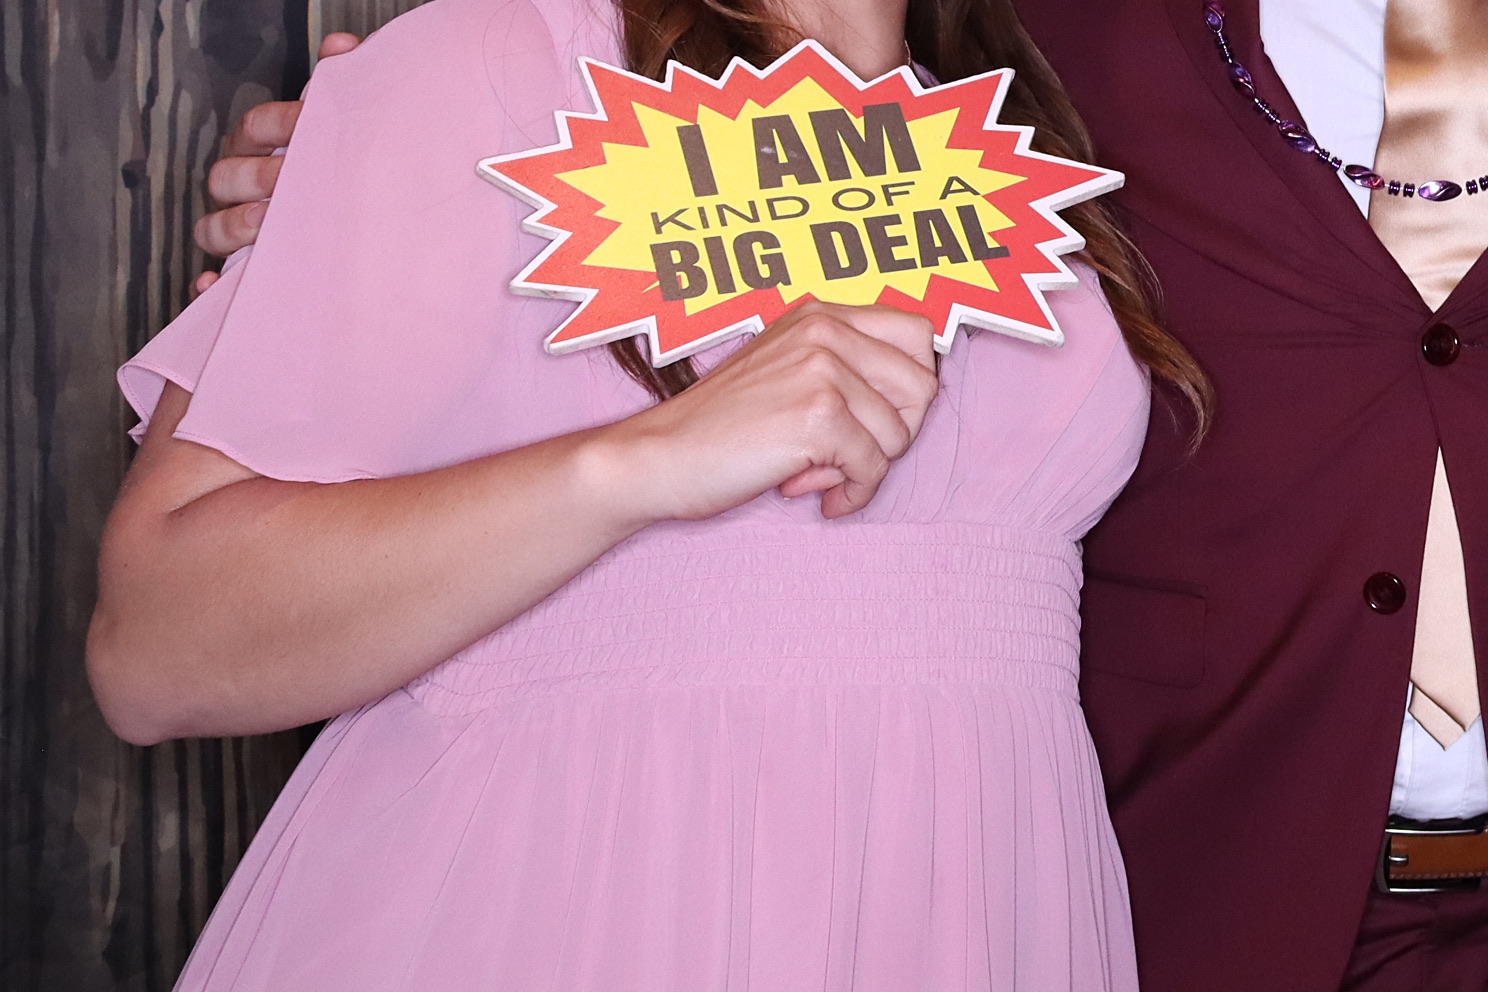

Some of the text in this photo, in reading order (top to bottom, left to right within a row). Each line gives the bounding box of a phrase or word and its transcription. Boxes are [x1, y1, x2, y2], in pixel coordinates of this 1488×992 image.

[676, 101, 923, 198] I AM
[649, 203, 1011, 302] BIG DEAL
[650, 174, 982, 235] KIND OF A
